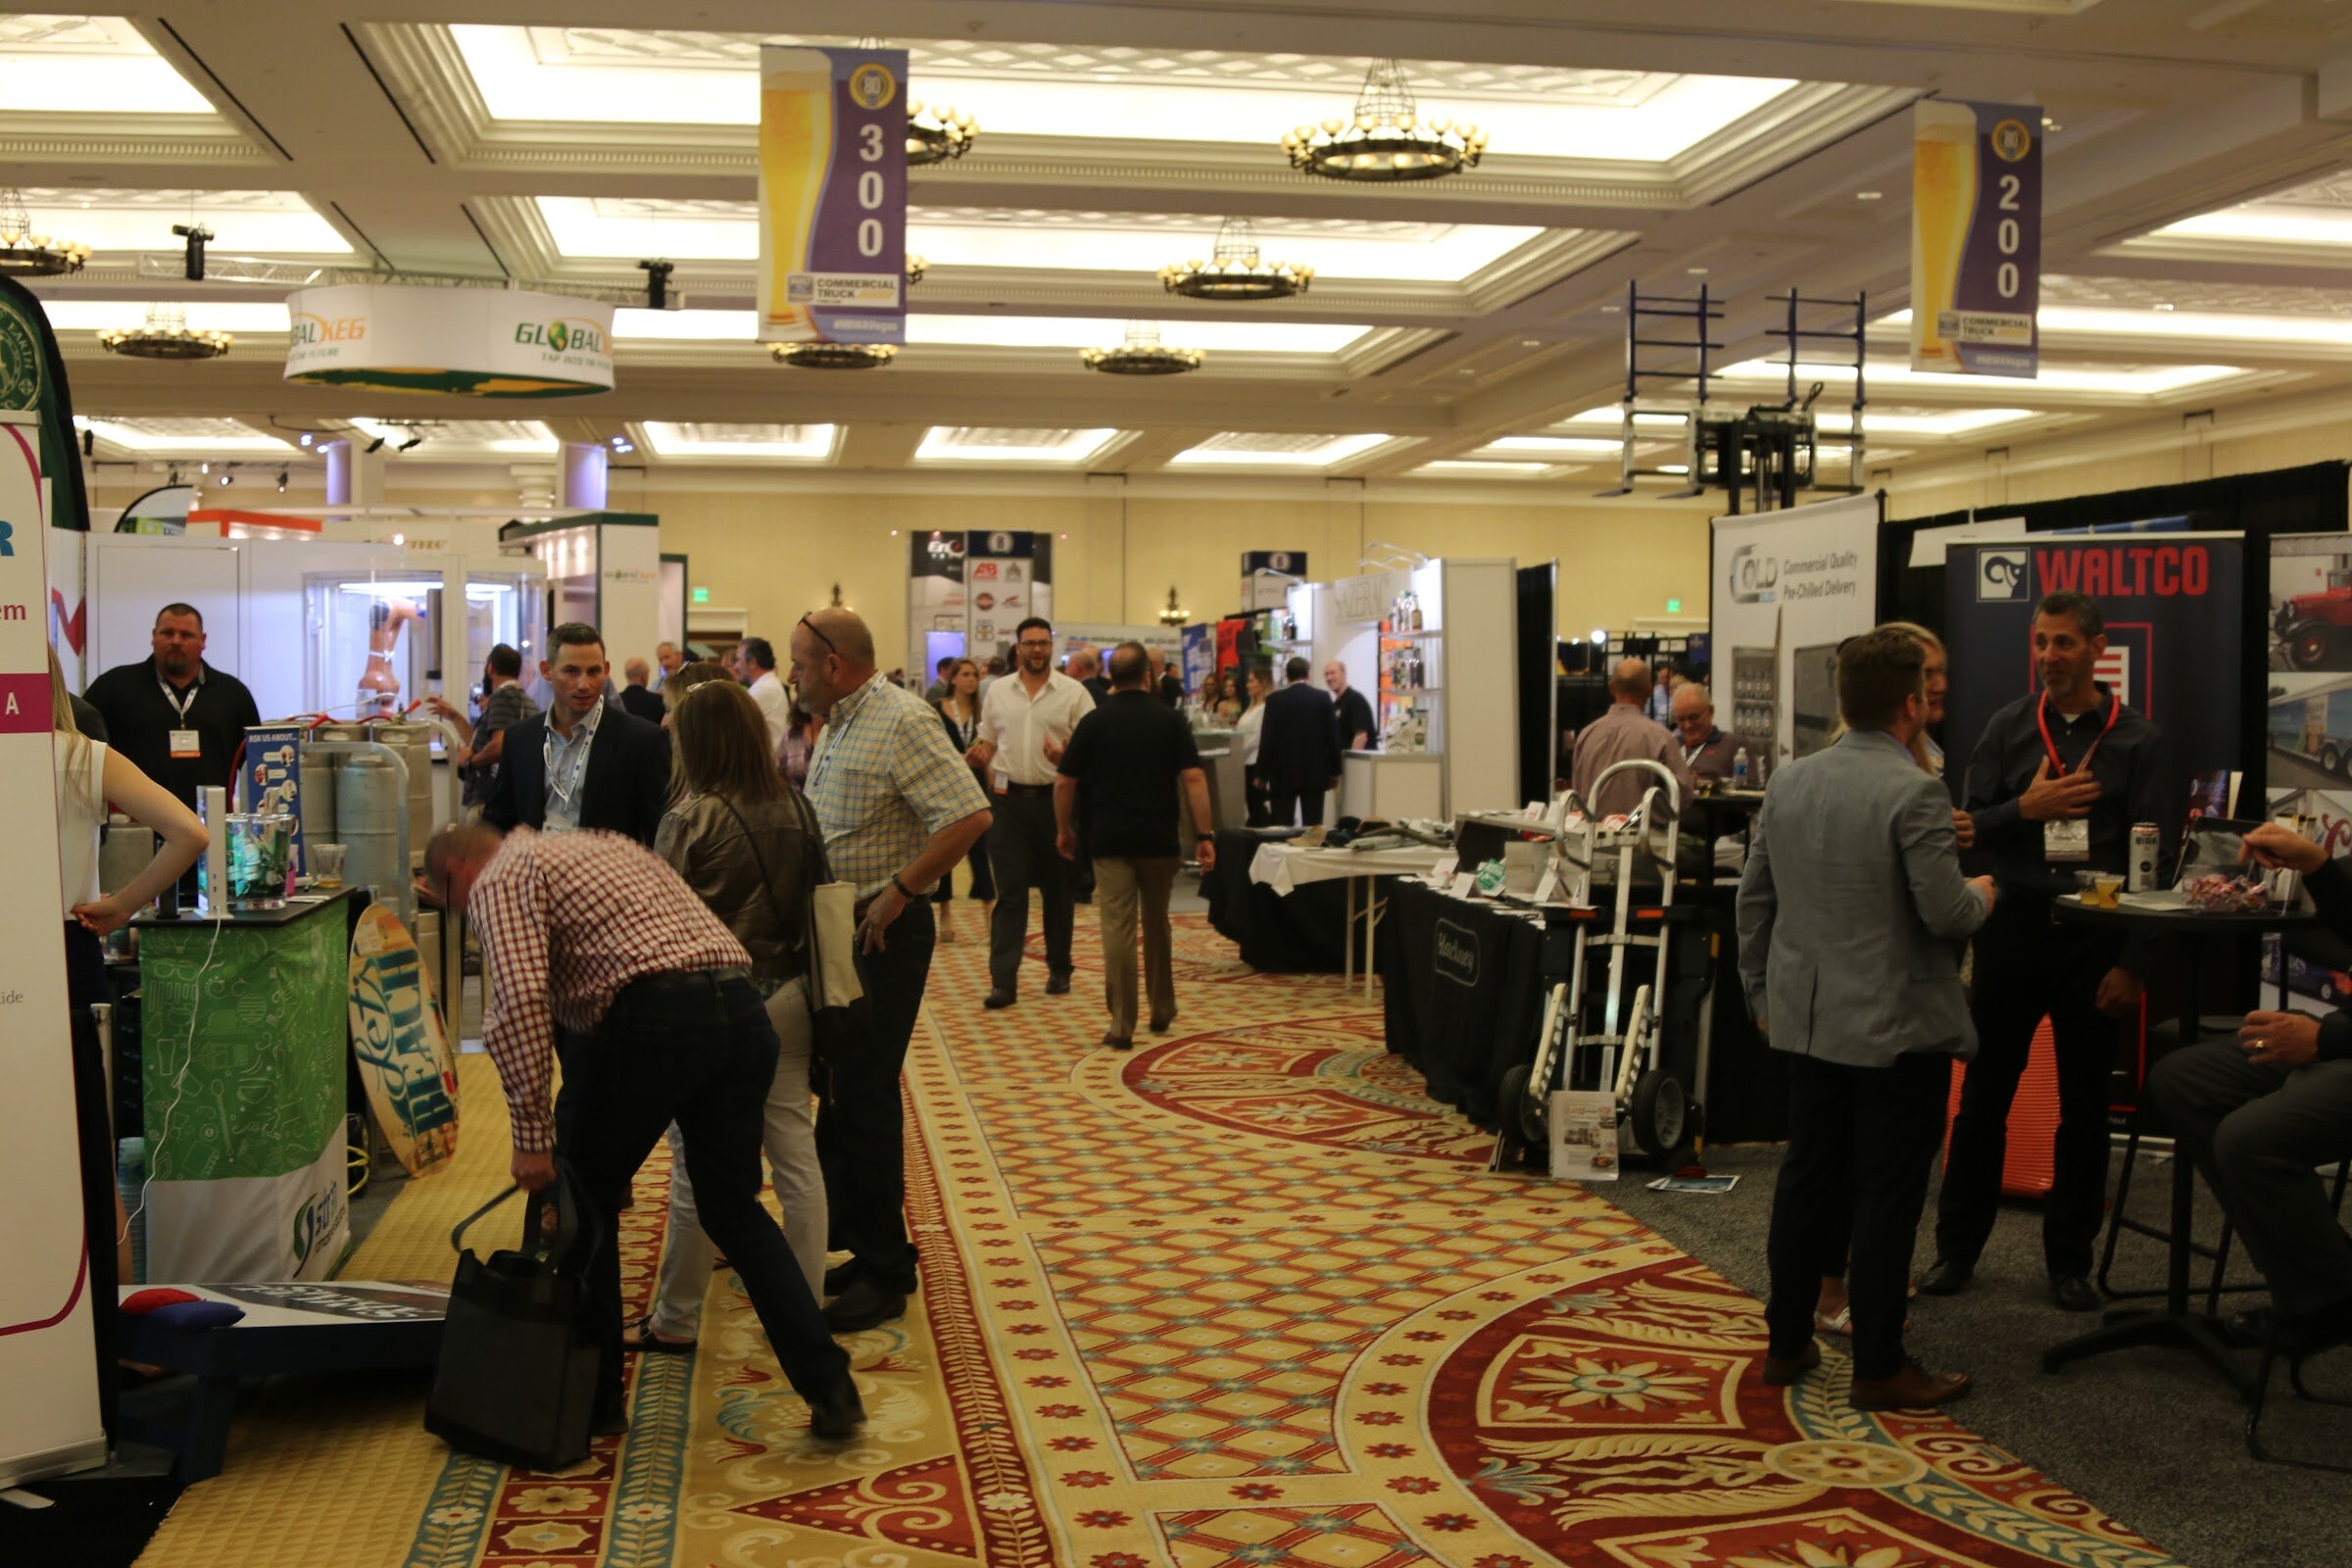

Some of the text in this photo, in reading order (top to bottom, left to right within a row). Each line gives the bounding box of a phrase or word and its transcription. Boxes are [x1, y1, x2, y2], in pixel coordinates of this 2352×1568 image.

[858, 123, 884, 257] 300
[1997, 174, 2020, 298] 200
[817, 278, 896, 290] COMMERCIAL
[817, 288, 856, 299] TRUCK
[1963, 317, 2029, 328] COMMERCIAL
[1963, 326, 1995, 336] TRUCK
[1784, 551, 1858, 575] Commercial Quality
[2036, 545, 2209, 597] WALTCO
[1825, 578, 1856, 598] Delivery
[0, 604, 26, 620] m
[6, 692, 20, 714] A
